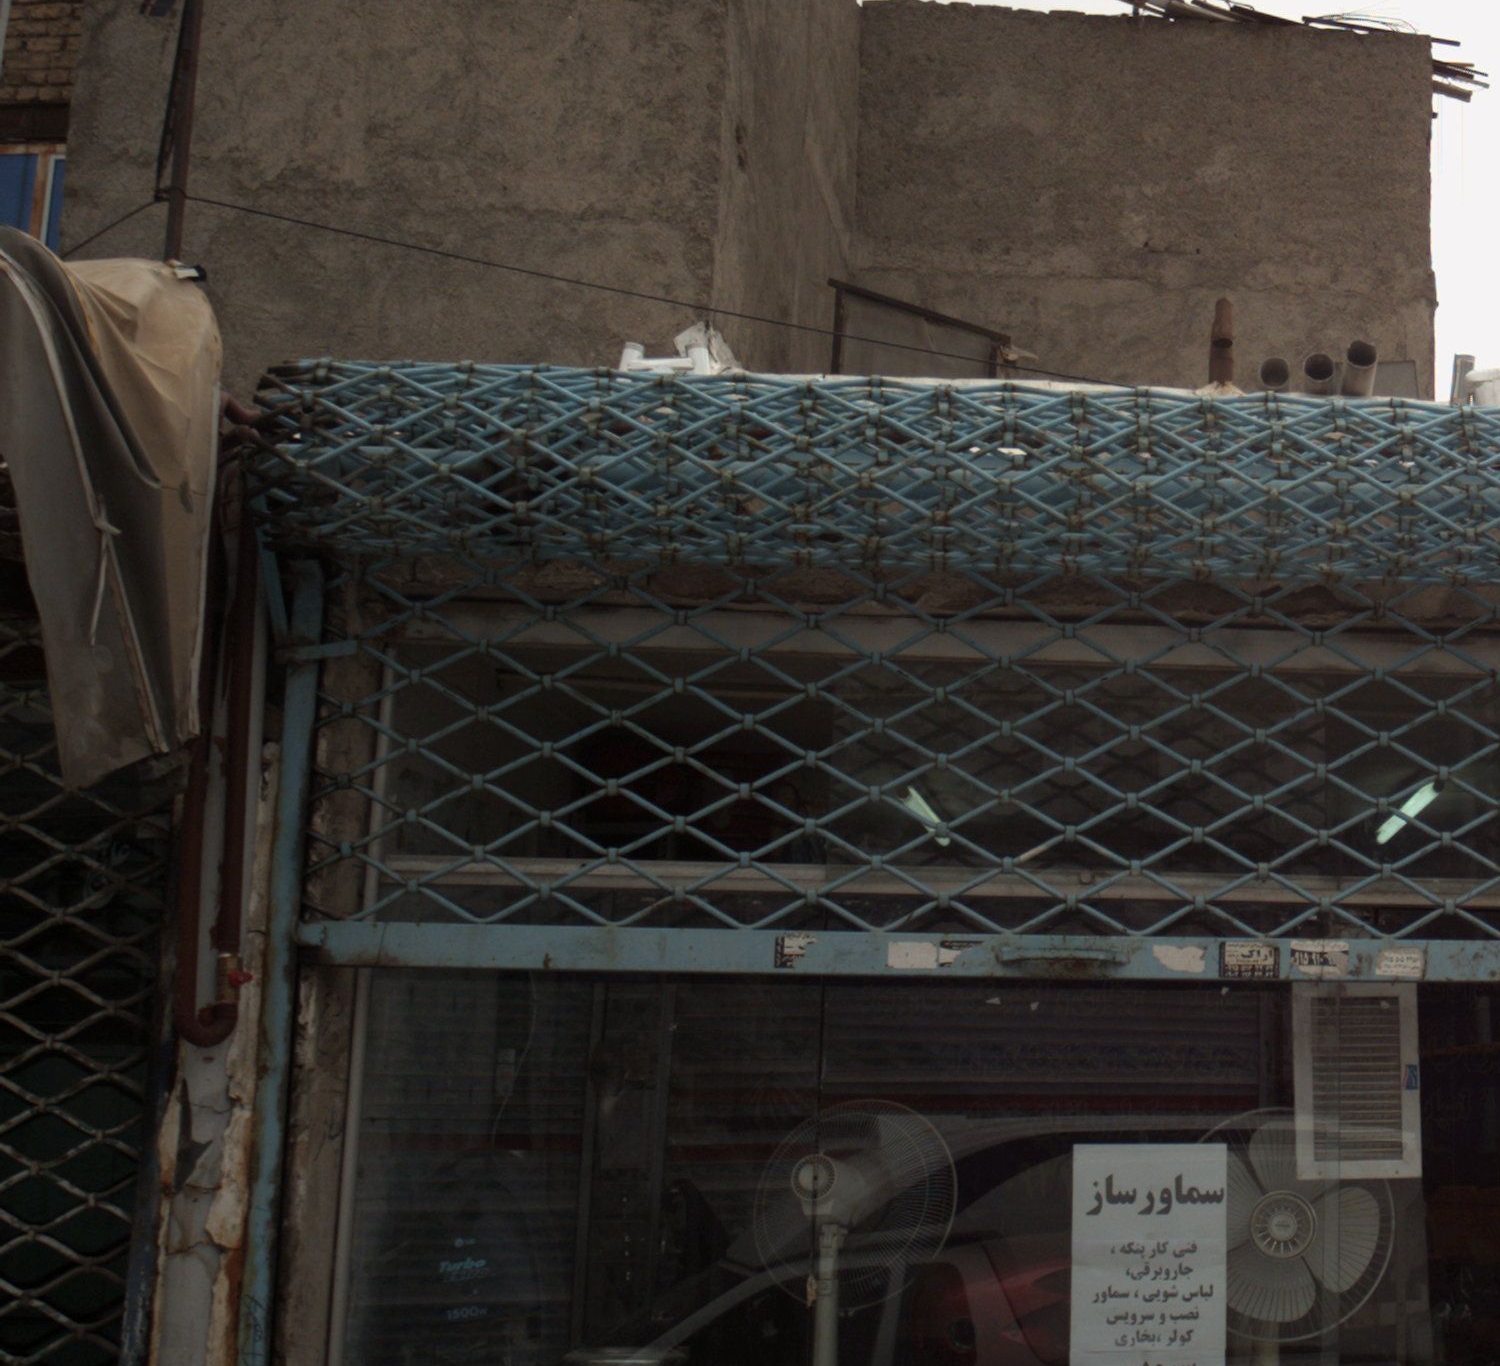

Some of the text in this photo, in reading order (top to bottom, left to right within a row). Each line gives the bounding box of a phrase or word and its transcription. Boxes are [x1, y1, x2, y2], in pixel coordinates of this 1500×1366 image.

[1120, 1242, 1145, 1258] پنکه
[1150, 1241, 1169, 1258] کار
[1173, 1242, 1198, 1257] فنی
[439, 1257, 487, 1272] Turbo
[1092, 1286, 1129, 1304] سماور
[1182, 1285, 1213, 1301] لباس
[1106, 1307, 1199, 1324] نصب و سرویس
[1167, 1329, 1194, 1346] کولر
